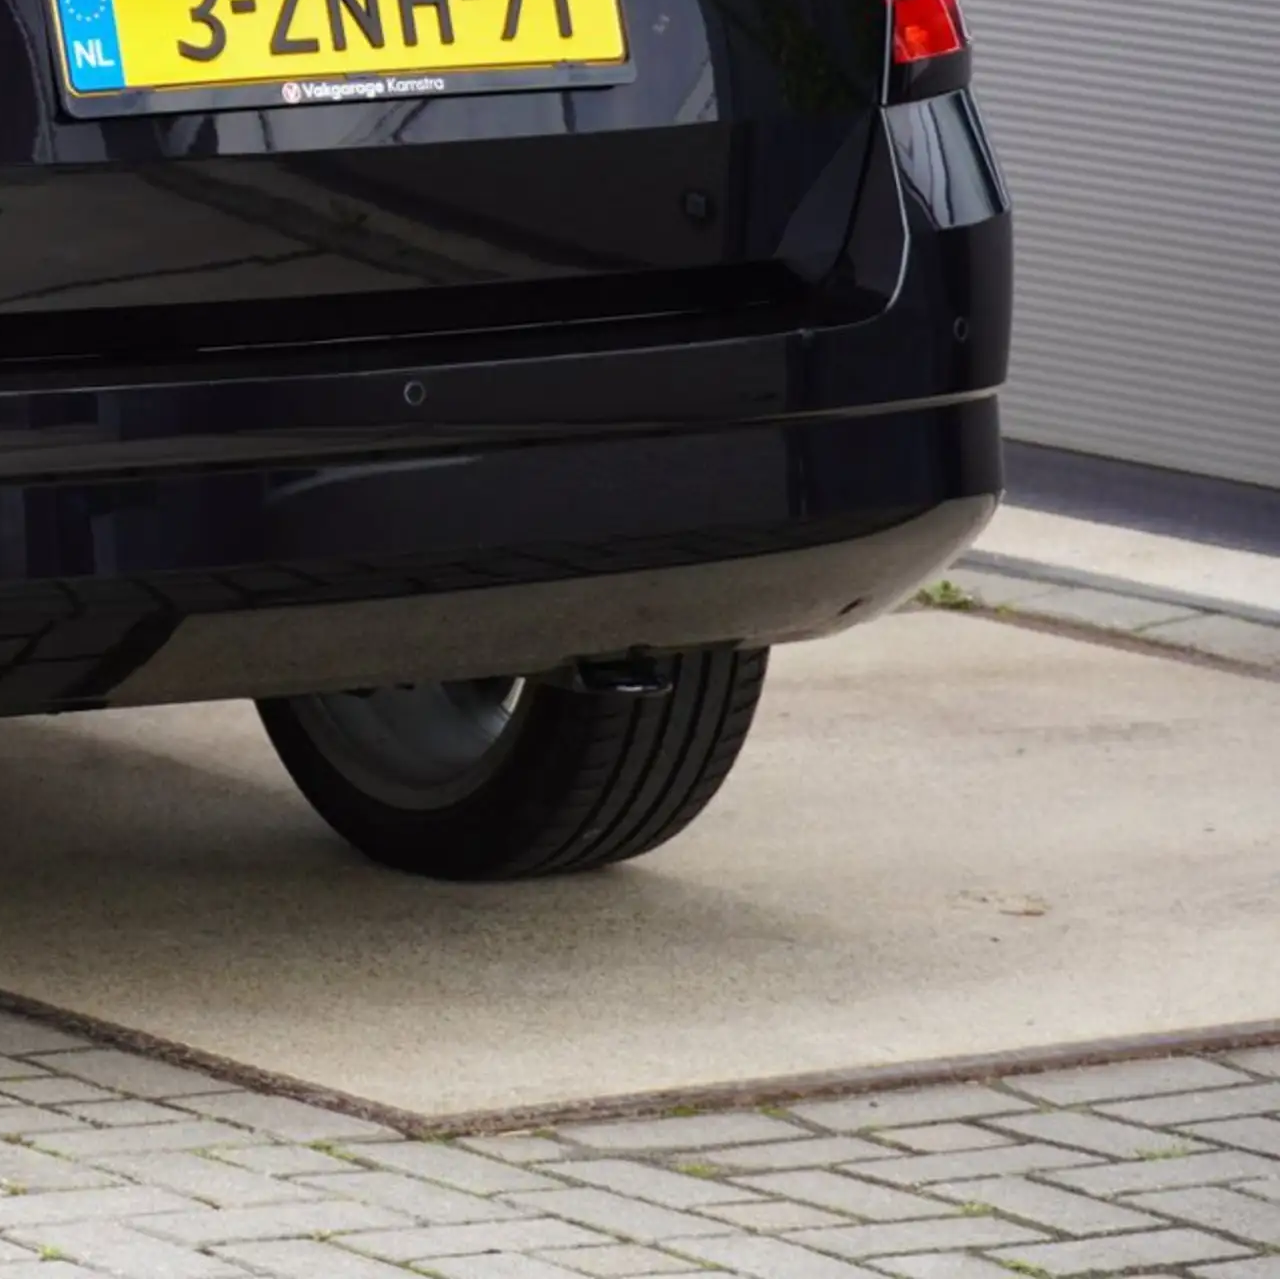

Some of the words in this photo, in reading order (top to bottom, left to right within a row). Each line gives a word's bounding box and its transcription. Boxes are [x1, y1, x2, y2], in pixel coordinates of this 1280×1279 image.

[73, 39, 115, 69] NL
[303, 81, 384, 99] Vakgarage
[387, 76, 445, 93] Kamstra
